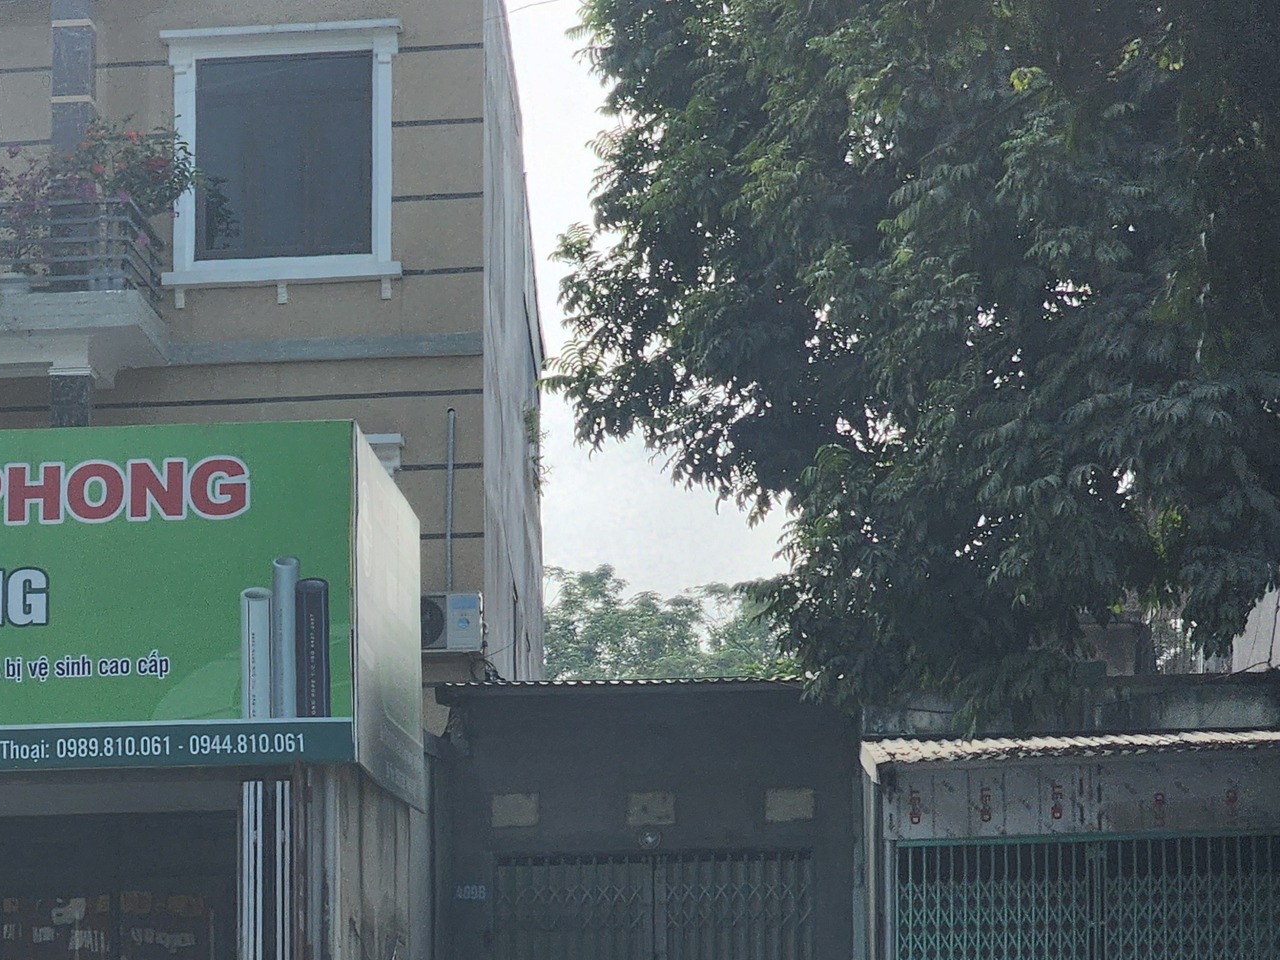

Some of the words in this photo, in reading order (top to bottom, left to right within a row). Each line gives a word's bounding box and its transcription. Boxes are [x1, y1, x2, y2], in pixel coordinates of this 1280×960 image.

[5, 658, 21, 683] bị
[28, 656, 50, 681] vệ
[55, 655, 92, 677] sinh
[99, 656, 130, 676] cao
[137, 650, 171, 678] cấp
[0, 738, 50, 763] Thoại:
[56, 734, 171, 758] 0989.810.061
[189, 733, 305, 755] 0944.810.061
